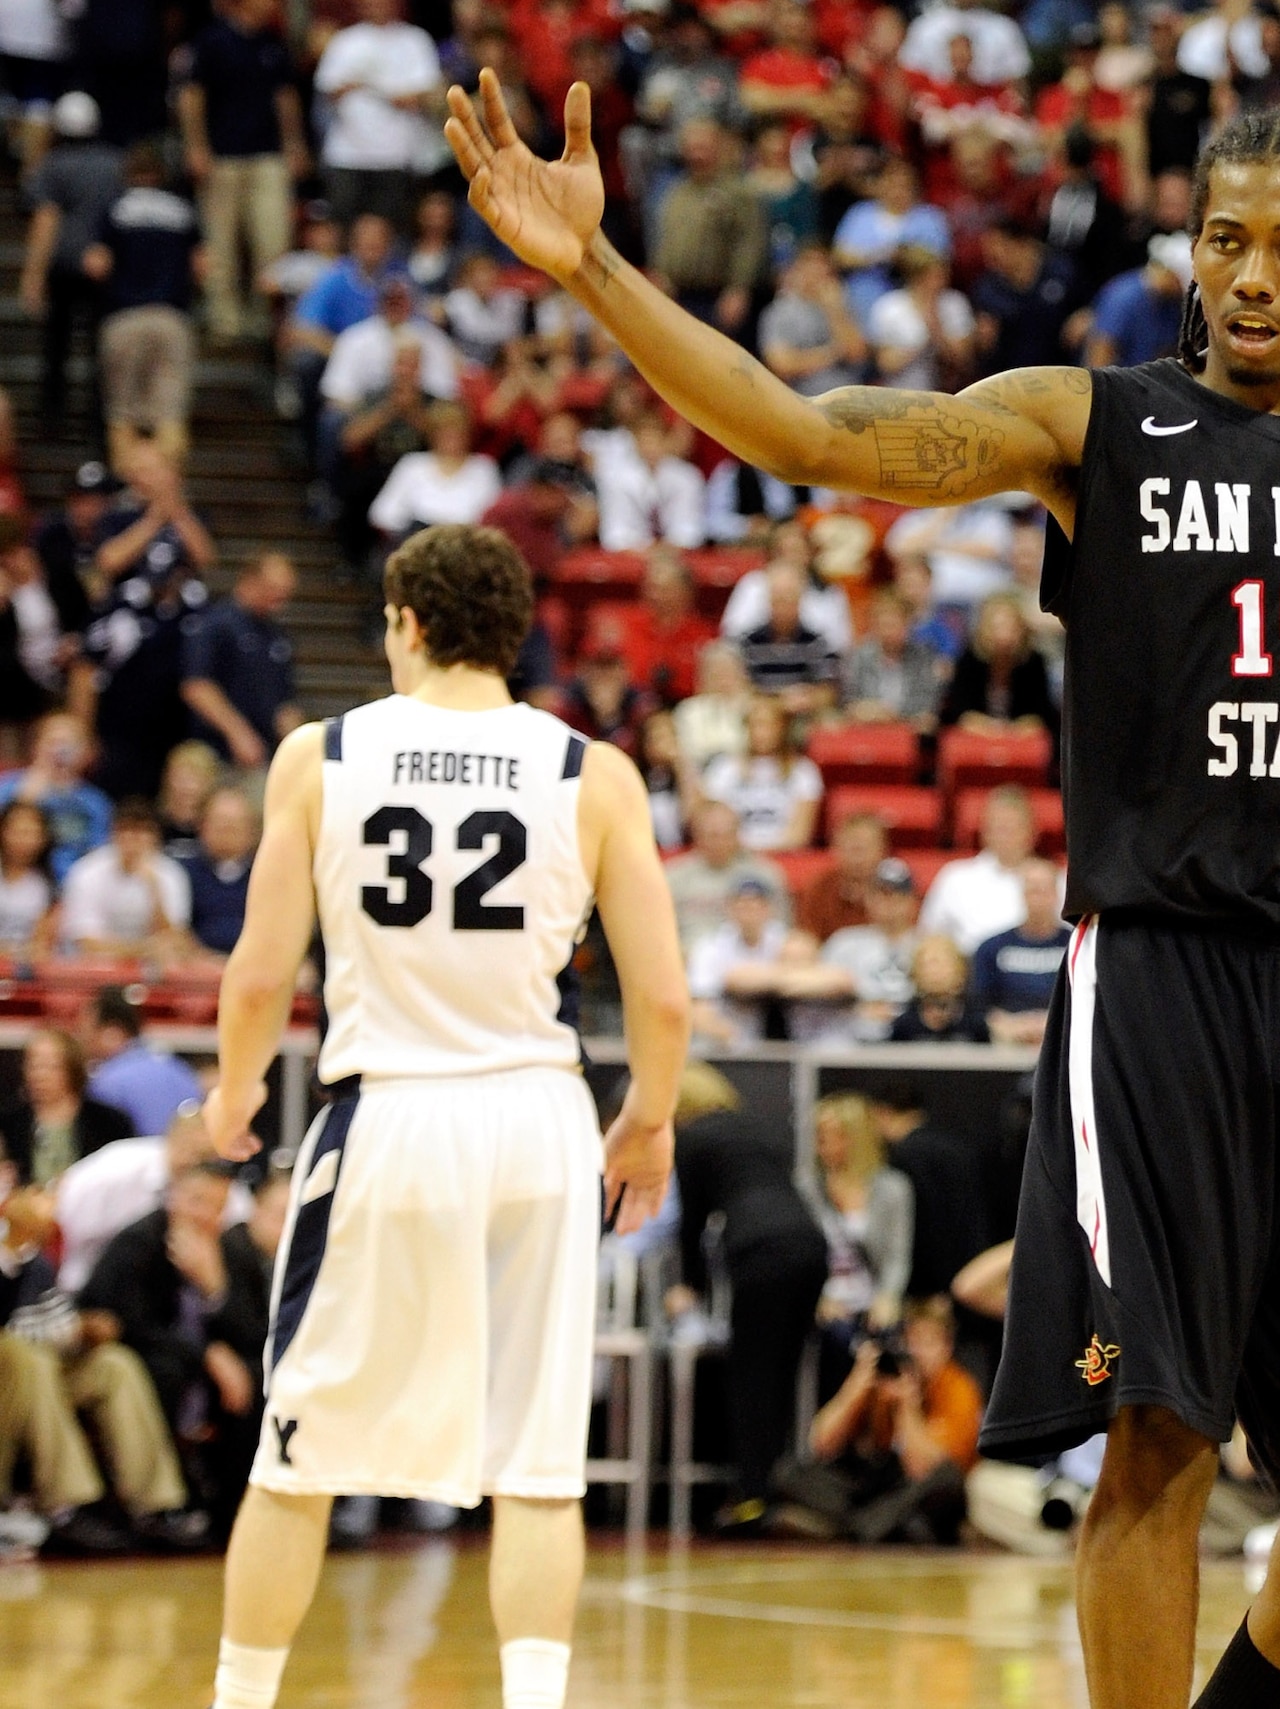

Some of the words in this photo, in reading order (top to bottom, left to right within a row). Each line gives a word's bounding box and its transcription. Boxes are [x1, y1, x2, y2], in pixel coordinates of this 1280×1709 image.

[1139, 477, 1251, 553] SAN
[393, 751, 519, 791] FREDETTE
[361, 806, 527, 930] 32
[273, 1416, 297, 1465] Y
